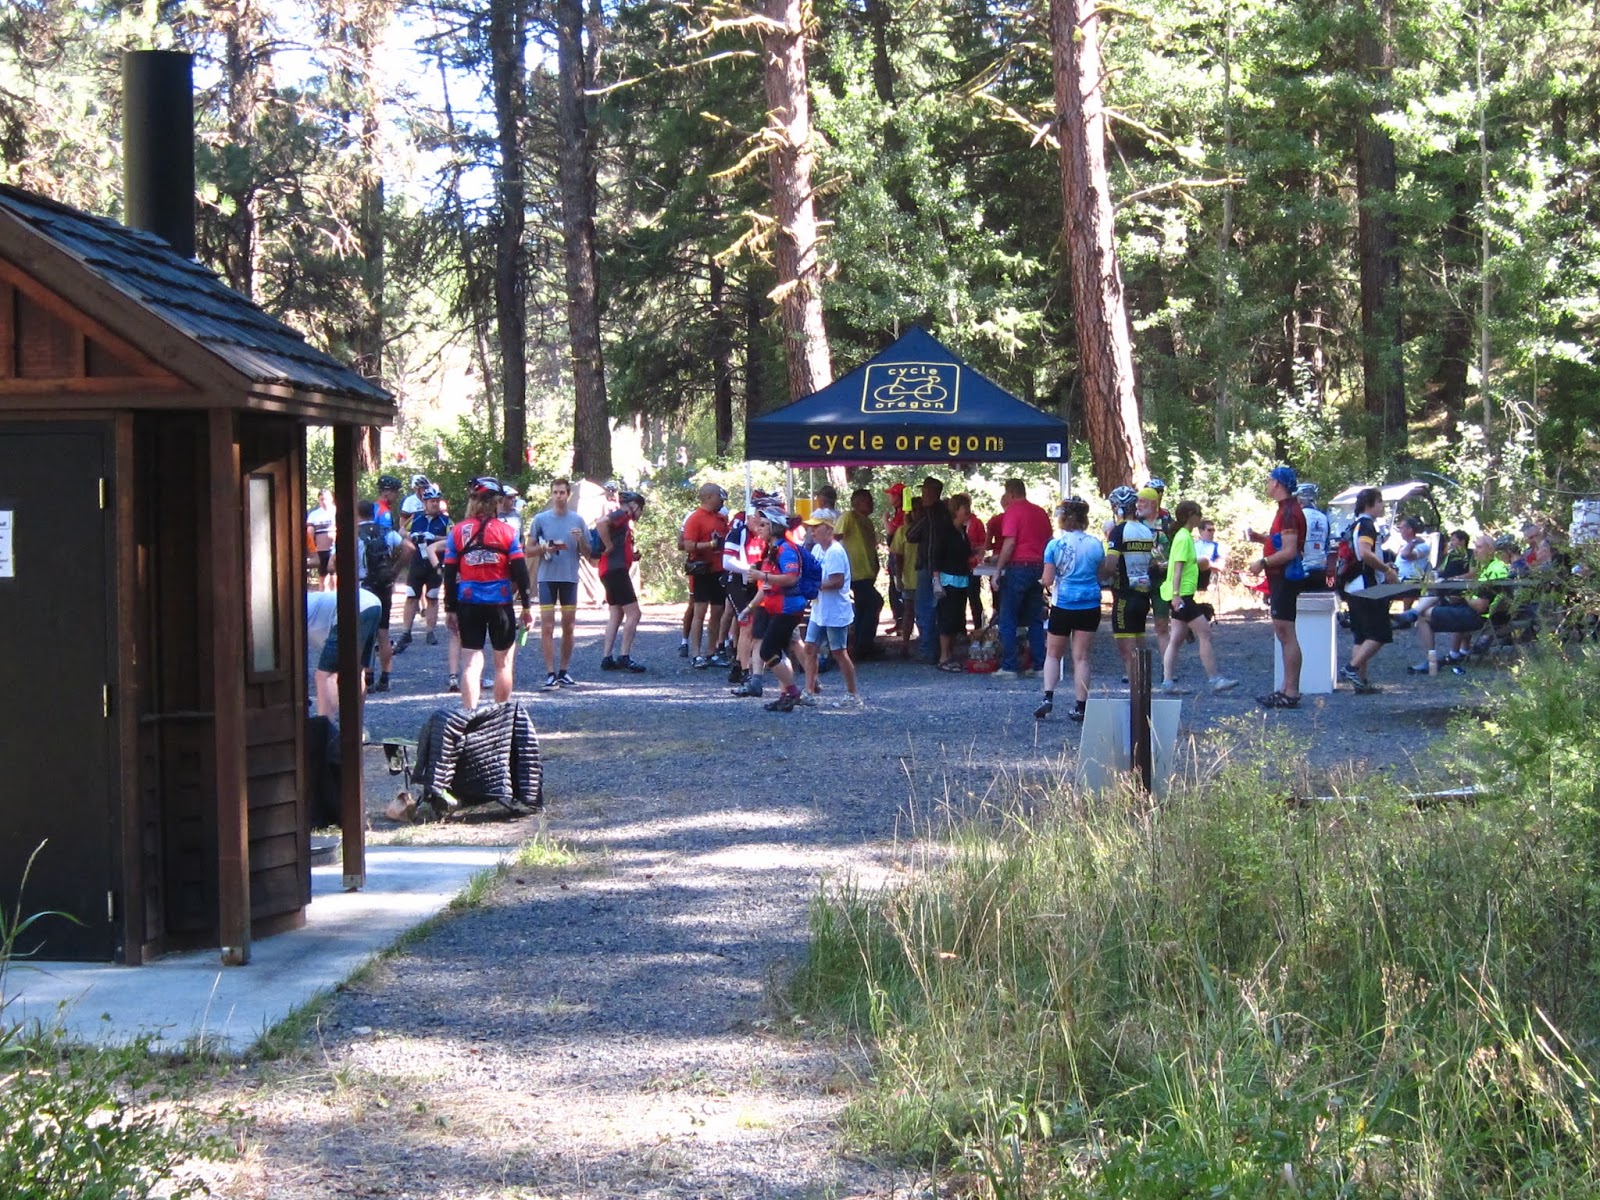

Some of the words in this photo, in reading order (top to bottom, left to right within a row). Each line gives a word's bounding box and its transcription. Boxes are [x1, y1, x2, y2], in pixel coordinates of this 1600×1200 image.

[888, 366, 938, 377] cycle
[875, 401, 944, 409] oregon
[808, 429, 884, 455] cycle
[895, 435, 998, 456] oregon
